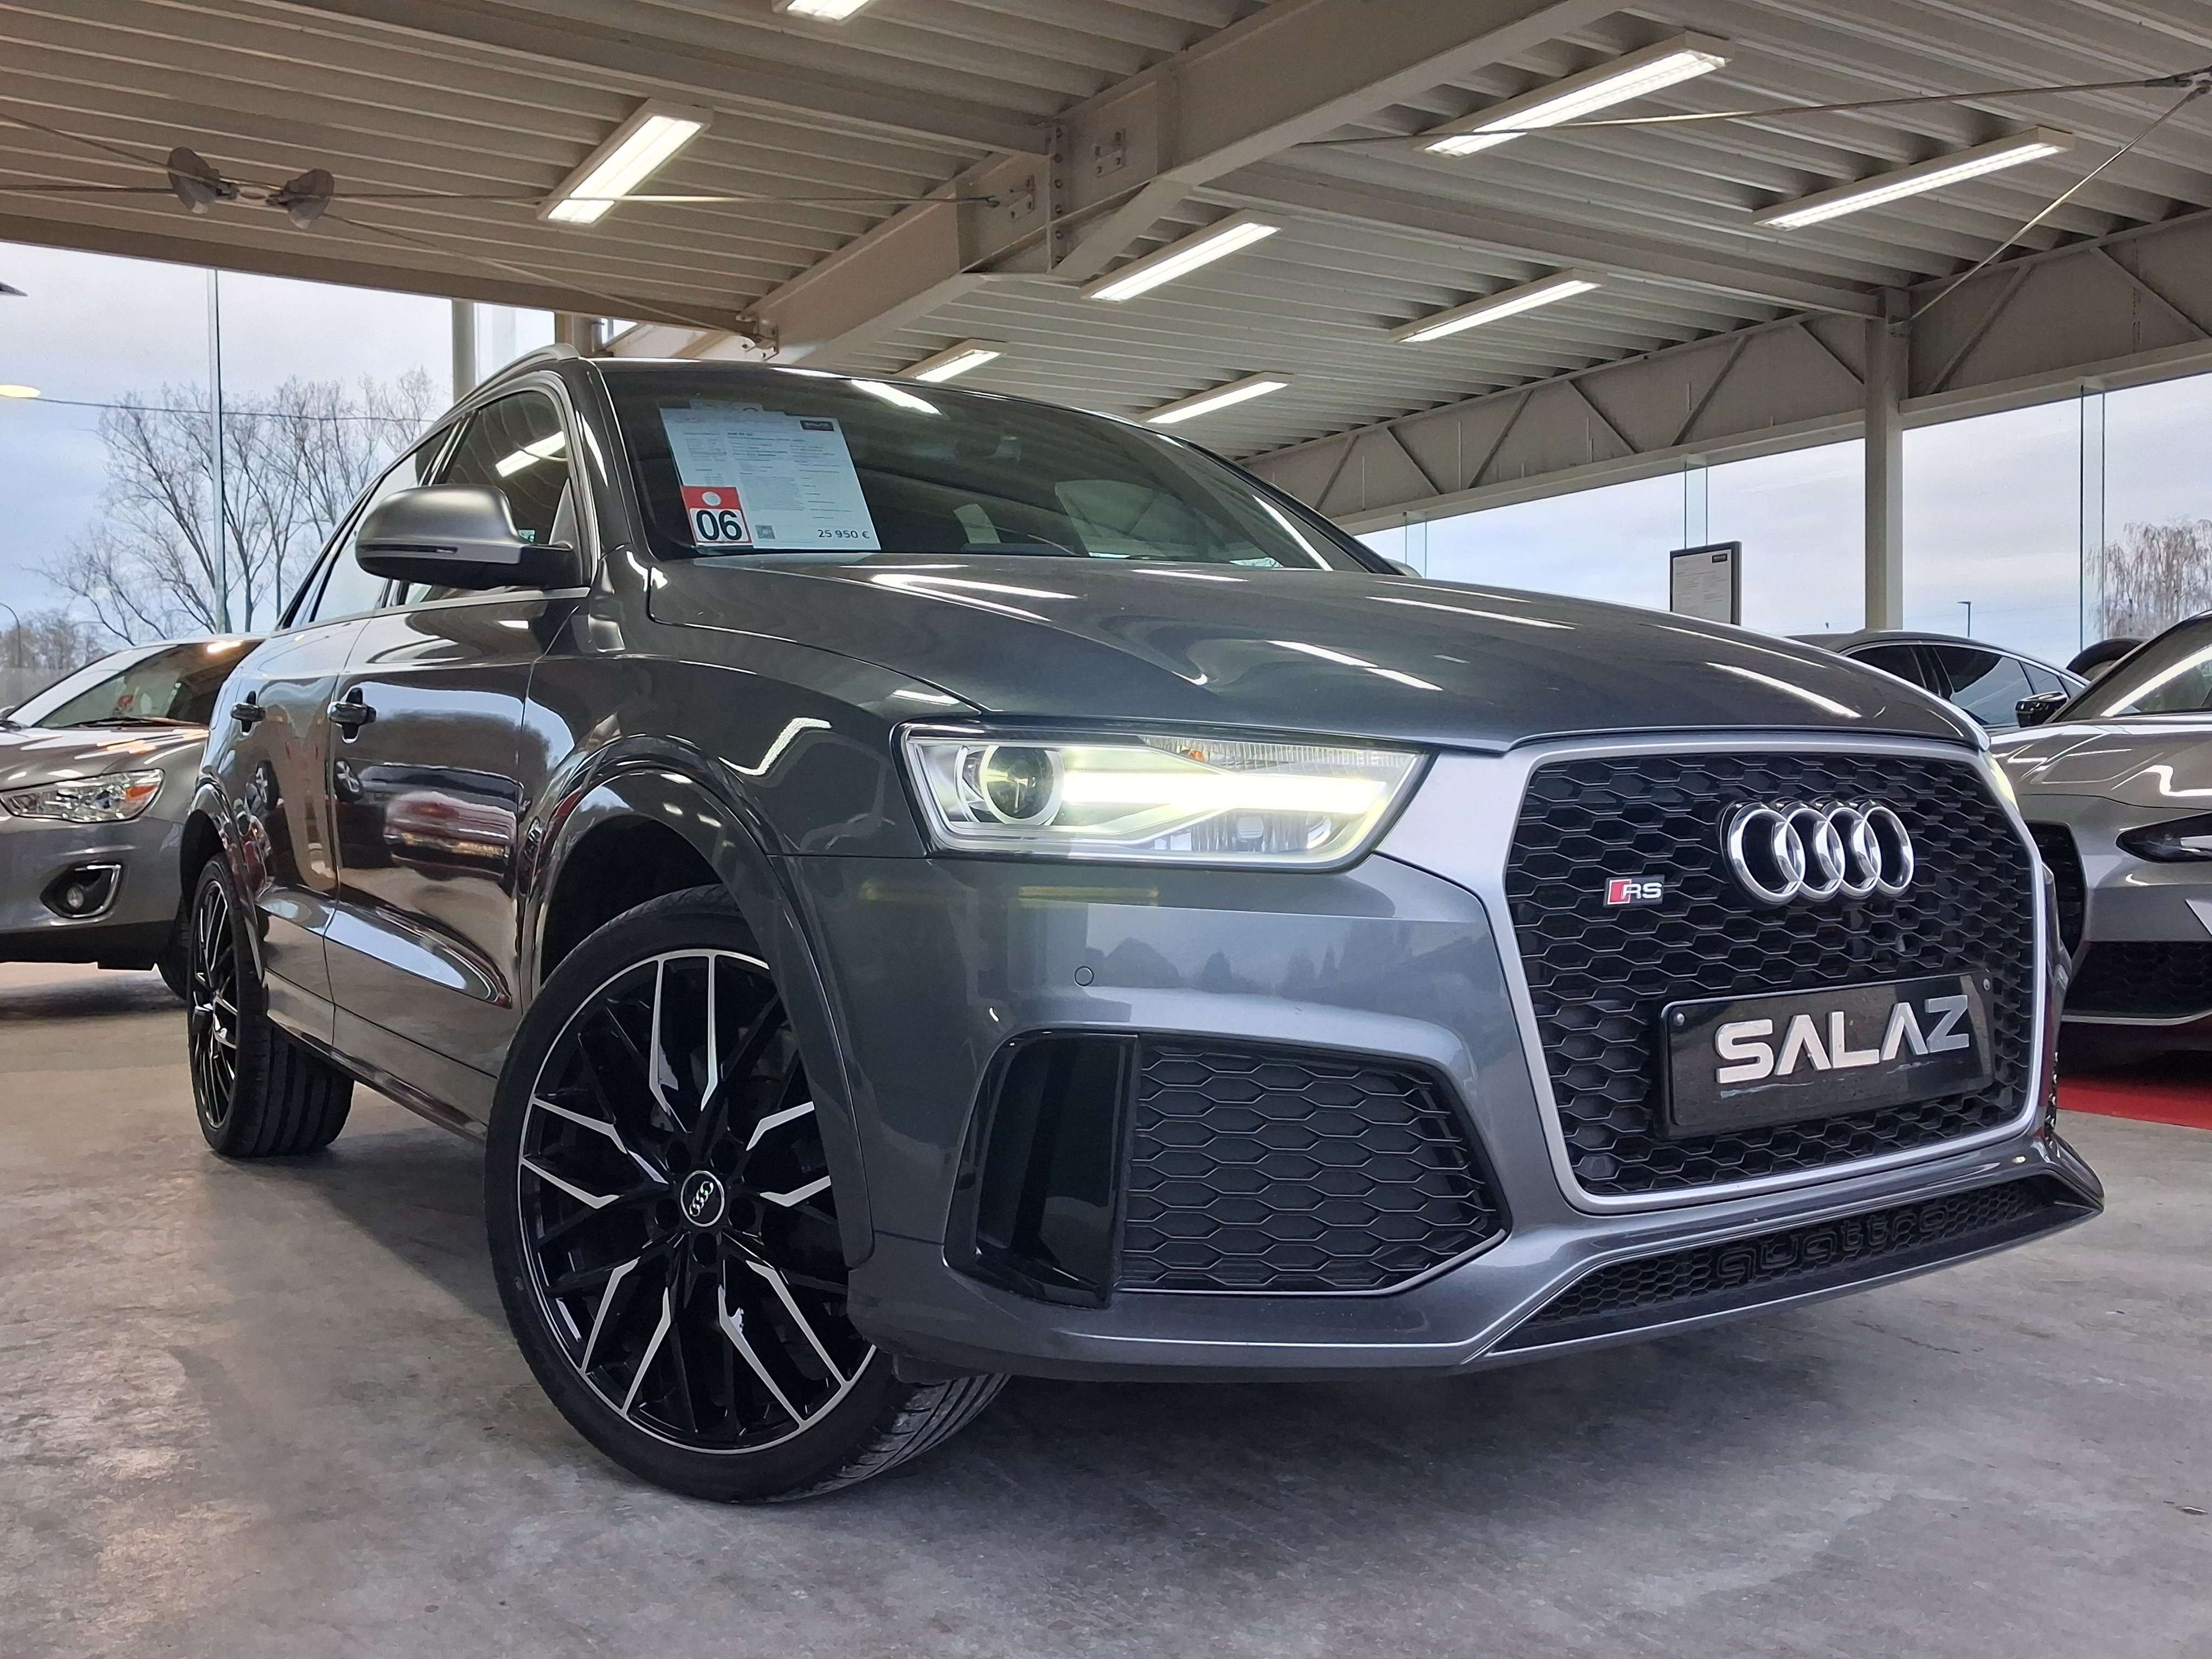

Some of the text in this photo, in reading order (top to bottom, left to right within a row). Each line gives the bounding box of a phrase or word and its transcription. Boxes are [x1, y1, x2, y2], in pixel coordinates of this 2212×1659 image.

[696, 510, 742, 541] 06
[818, 529, 832, 538] 25
[835, 530, 858, 538] 950
[1621, 882, 1662, 899] RS
[1716, 995, 1969, 1084] SALAZ
